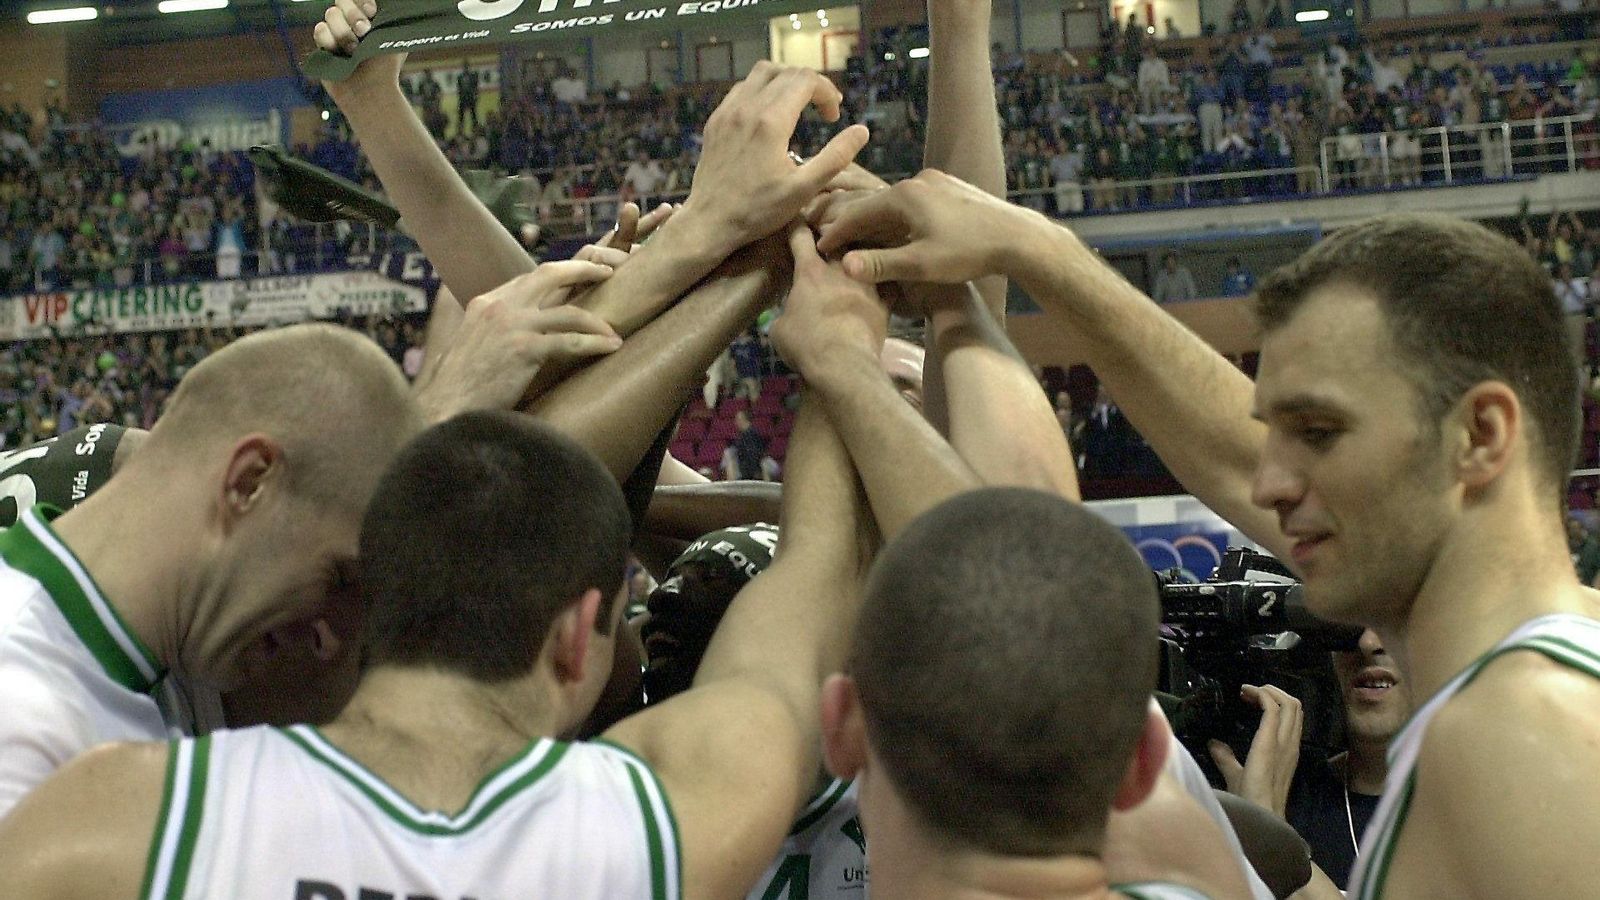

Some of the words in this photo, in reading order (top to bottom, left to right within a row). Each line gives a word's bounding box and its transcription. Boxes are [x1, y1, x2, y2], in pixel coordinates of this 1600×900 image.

[511, 14, 614, 33] SOMOS
[625, 8, 666, 21] UN
[24, 294, 67, 324] VIP
[72, 286, 204, 324] CATERING
[1258, 591, 1277, 617] 2
